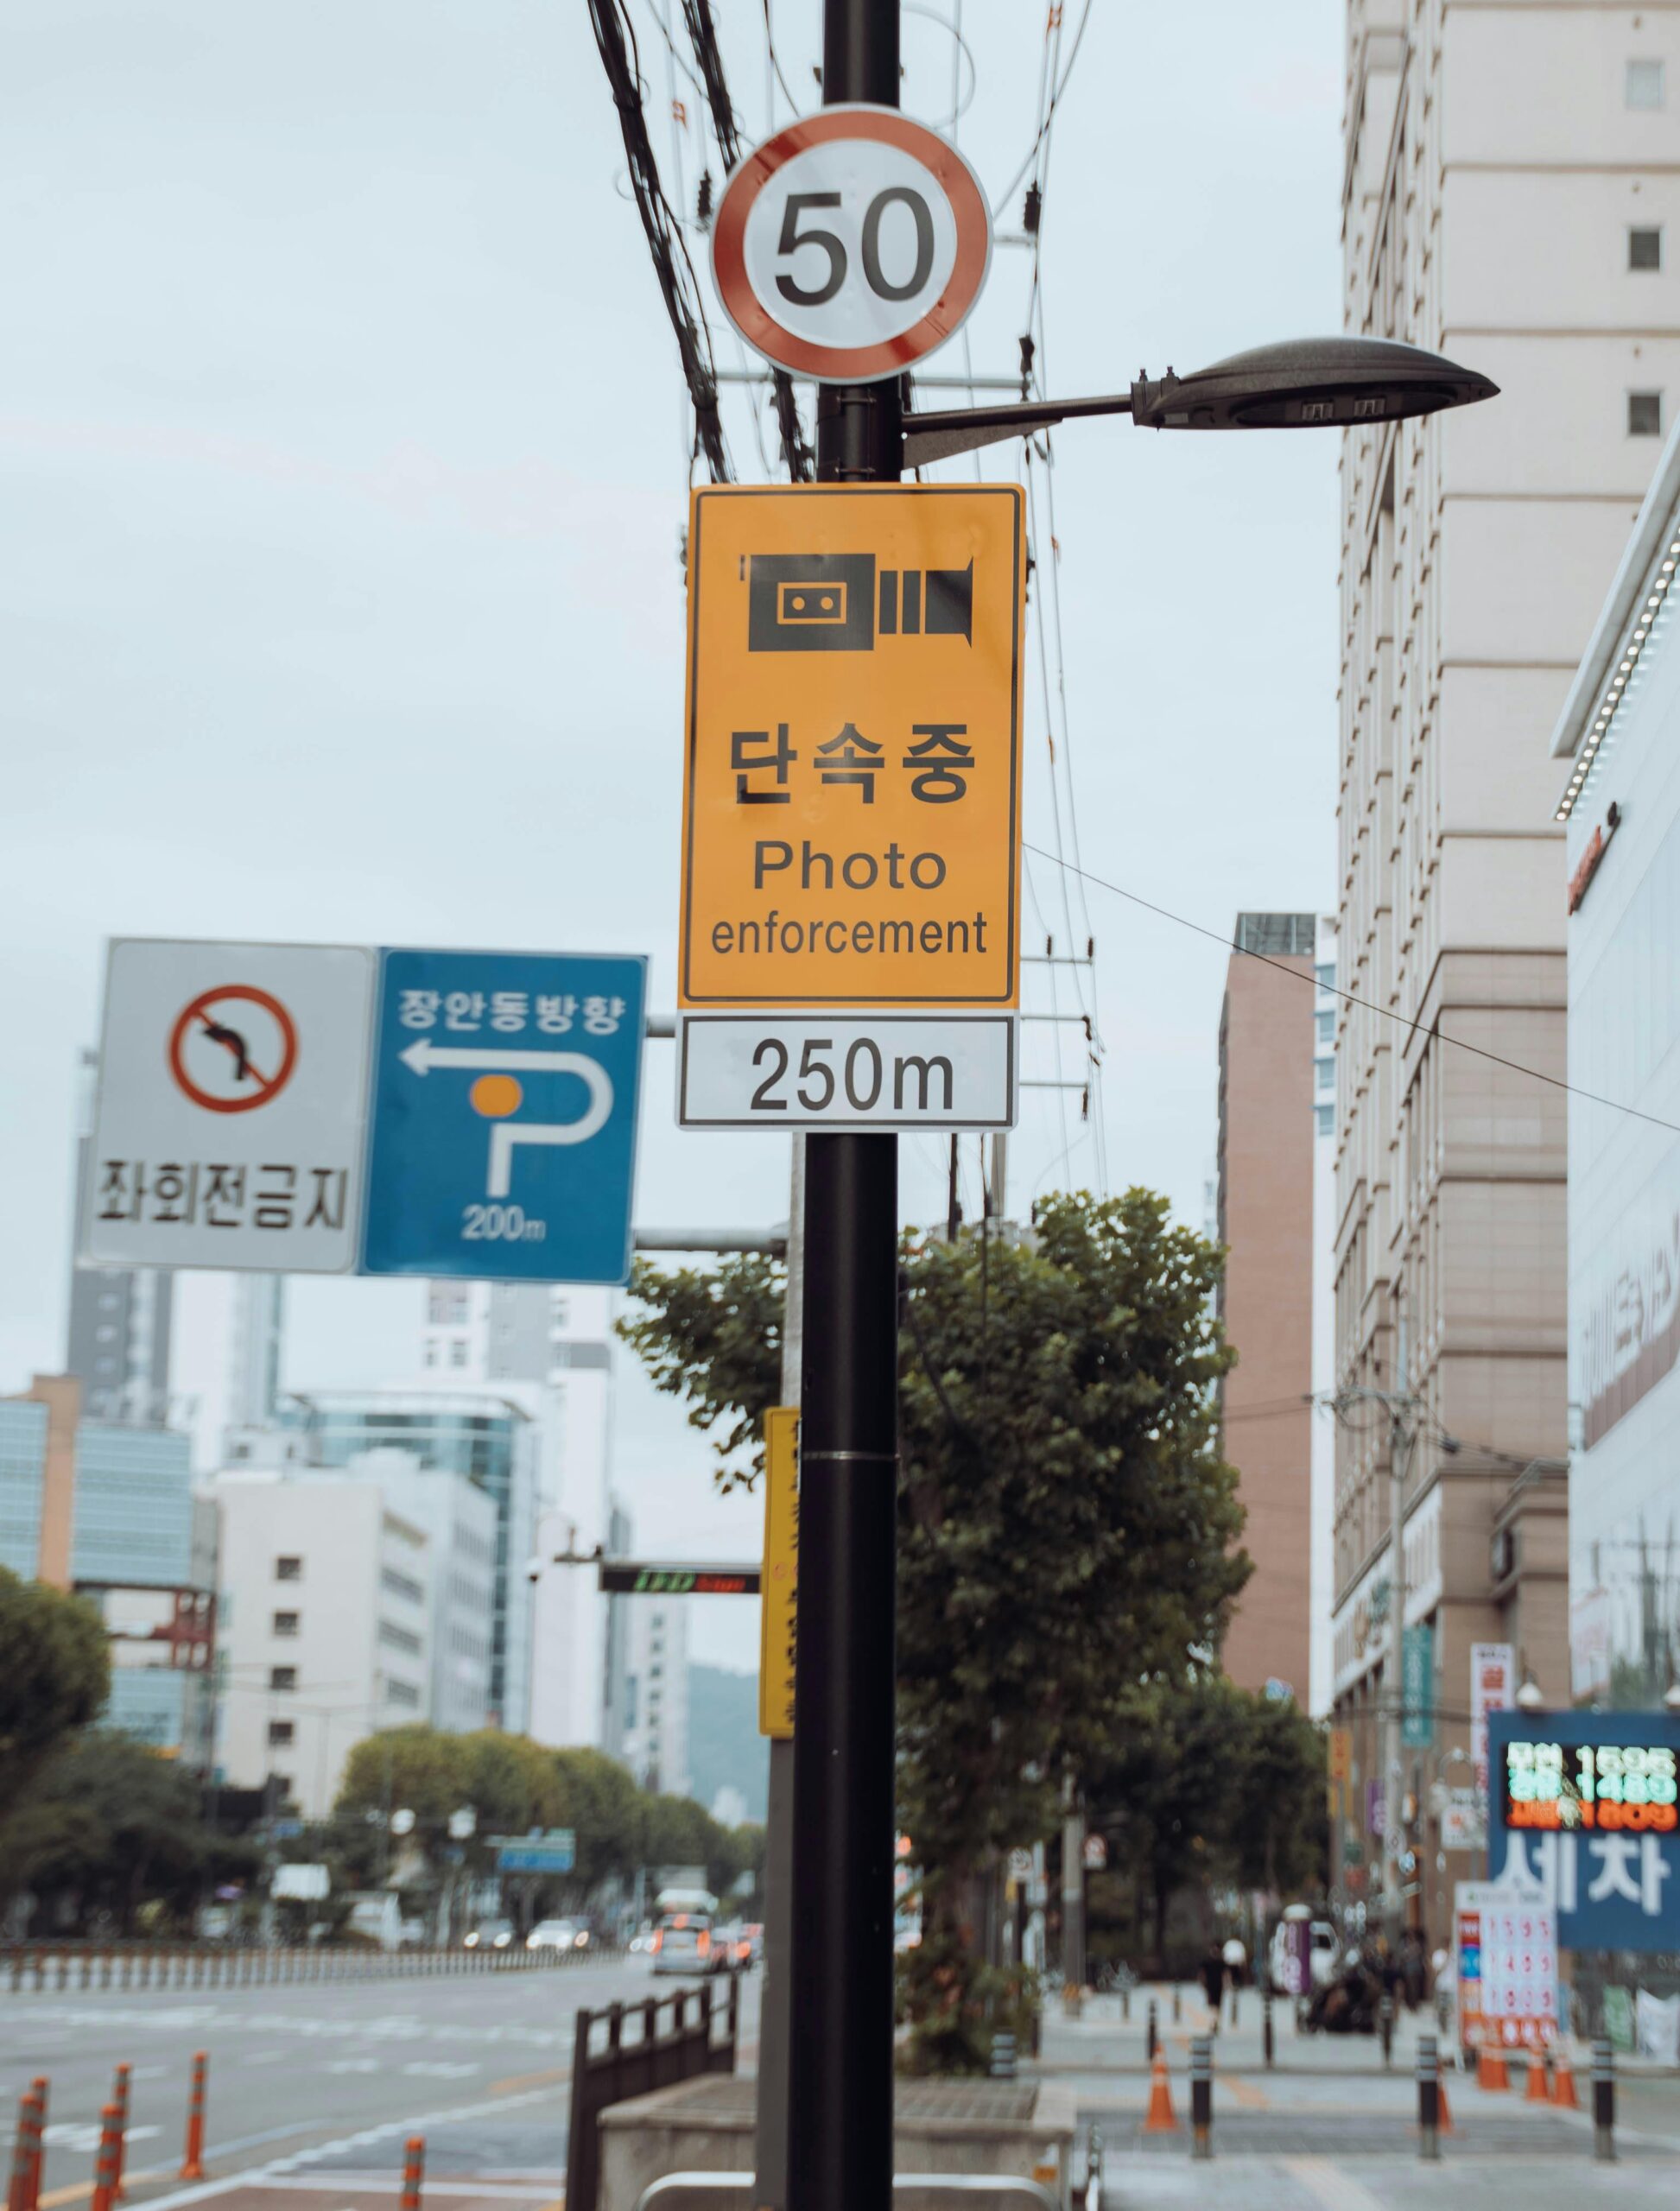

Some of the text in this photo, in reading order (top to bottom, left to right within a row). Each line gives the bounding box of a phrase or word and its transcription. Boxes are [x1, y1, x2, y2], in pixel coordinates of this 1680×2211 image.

[775, 187, 935, 307] 50
[729, 722, 976, 804] 단속중
[754, 840, 947, 890] Photo
[711, 909, 987, 953] enforcement
[398, 989, 626, 1036] 장안동방향
[751, 1037, 954, 1112] 250m
[98, 1160, 349, 1231] 좌회전금지
[461, 1203, 547, 1242] 200m
[1576, 1745, 1677, 1777] 1595
[1492, 1829, 1671, 1916] 세차
